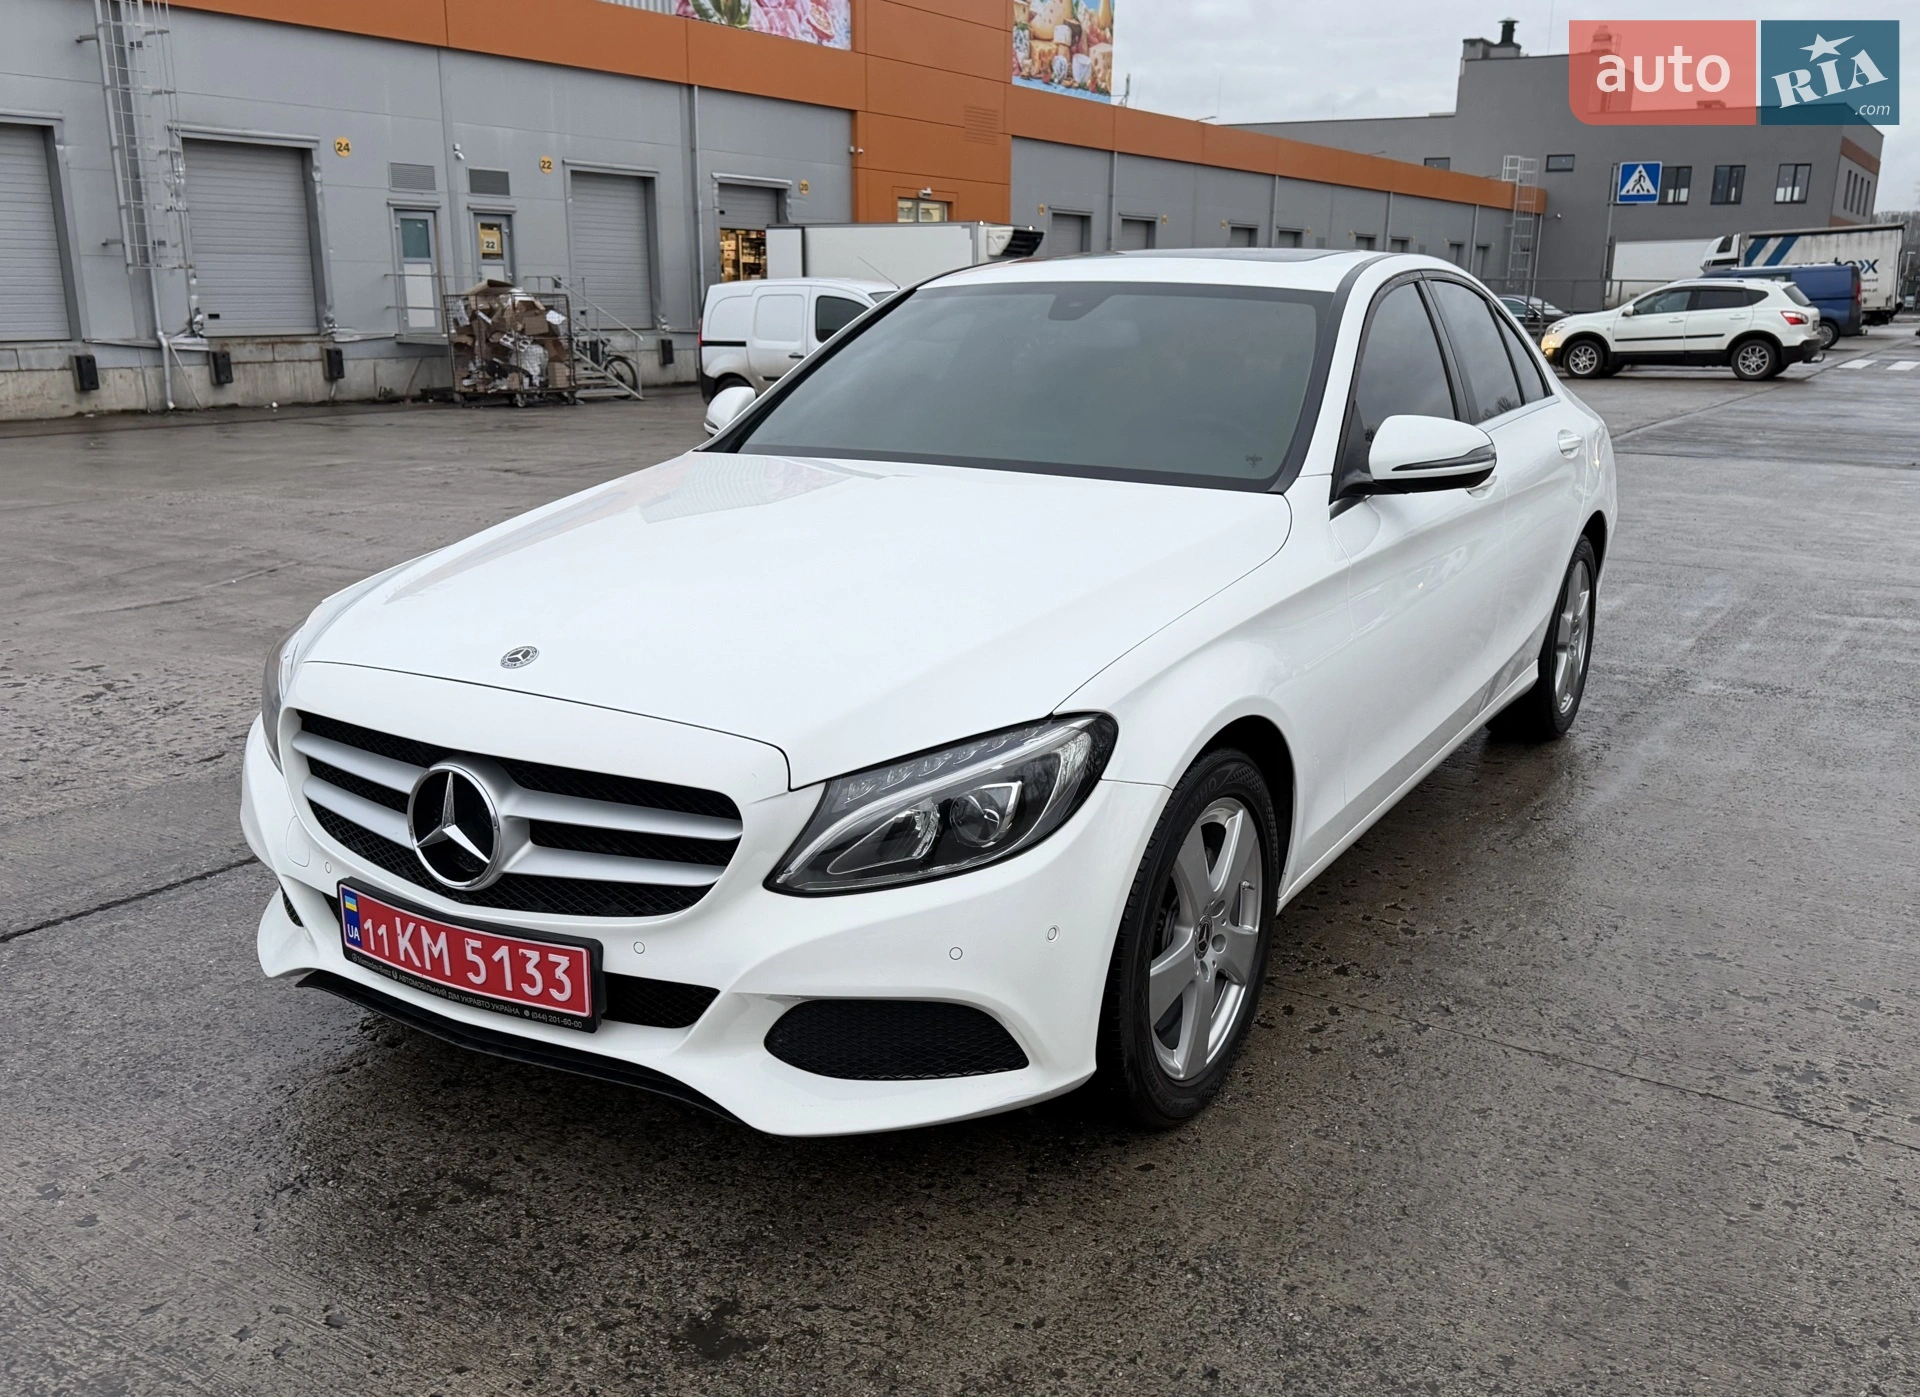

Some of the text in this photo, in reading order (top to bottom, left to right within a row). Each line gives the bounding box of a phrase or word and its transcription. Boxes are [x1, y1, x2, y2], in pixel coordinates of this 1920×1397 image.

[336, 141, 350, 152] 24
[541, 160, 552, 170] 22
[485, 241, 496, 249] 22
[347, 923, 360, 941] UA
[464, 937, 572, 1002] 5133
[460, 994, 491, 1009] УКРАВТО
[491, 1001, 520, 1015] УКРАЇНА
[531, 1011, 548, 1022] (044)
